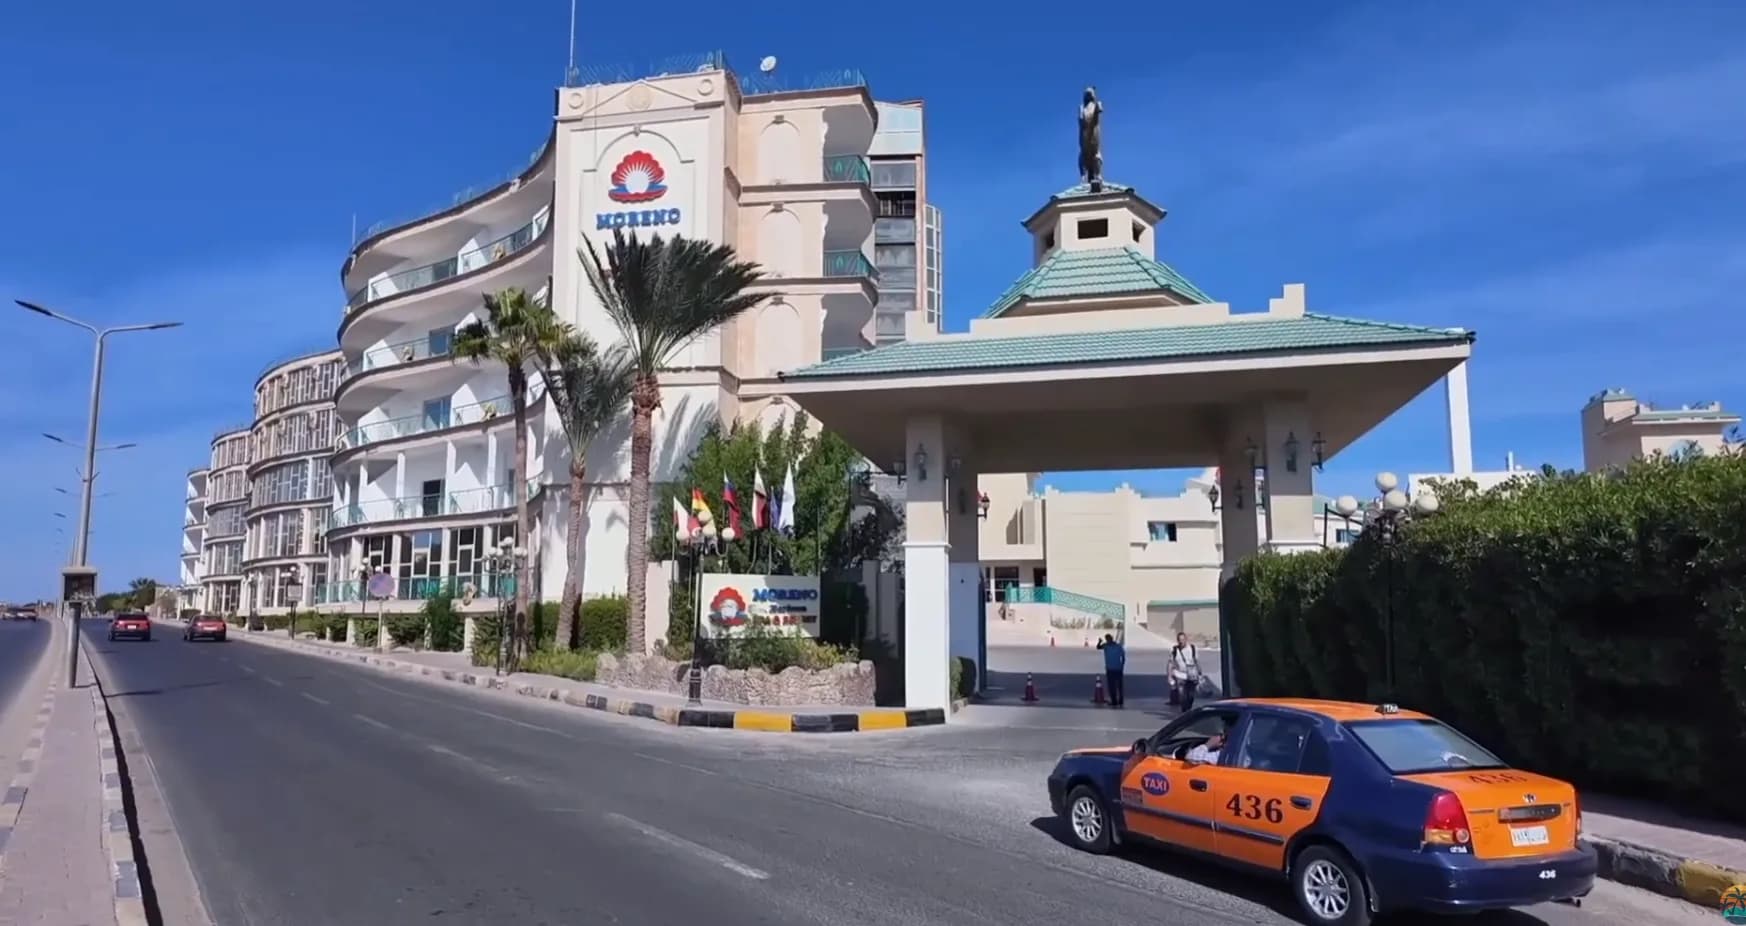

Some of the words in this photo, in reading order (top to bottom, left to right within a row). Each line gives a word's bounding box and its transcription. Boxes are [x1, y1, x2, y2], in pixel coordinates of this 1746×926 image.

[596, 208, 680, 230] MORENO
[752, 588, 818, 602] MORENO
[1143, 777, 1168, 792] TAXI
[1468, 773, 1528, 785] 436
[1226, 793, 1284, 824] 436
[1539, 870, 1556, 879] 436
